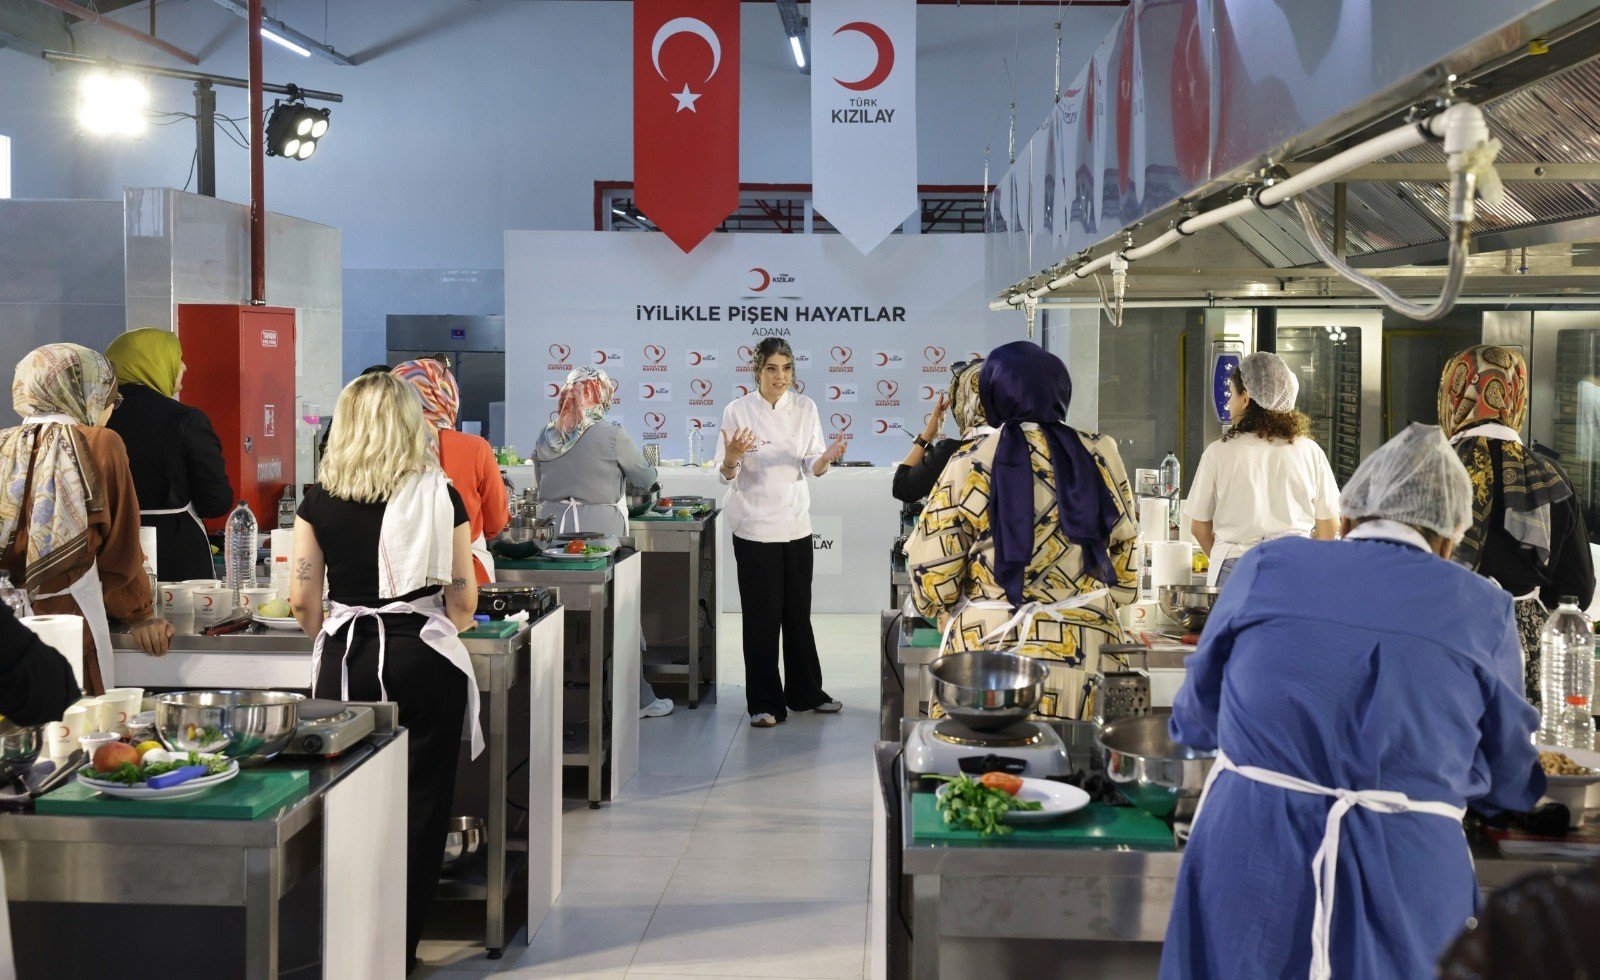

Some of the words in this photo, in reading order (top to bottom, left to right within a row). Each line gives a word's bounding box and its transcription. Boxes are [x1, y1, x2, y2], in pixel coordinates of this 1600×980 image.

[850, 97, 878, 107] TÜRK
[832, 109, 895, 123] KIZILAY
[796, 306, 905, 321] HAYATLAR
[752, 328, 791, 336] ADANA
